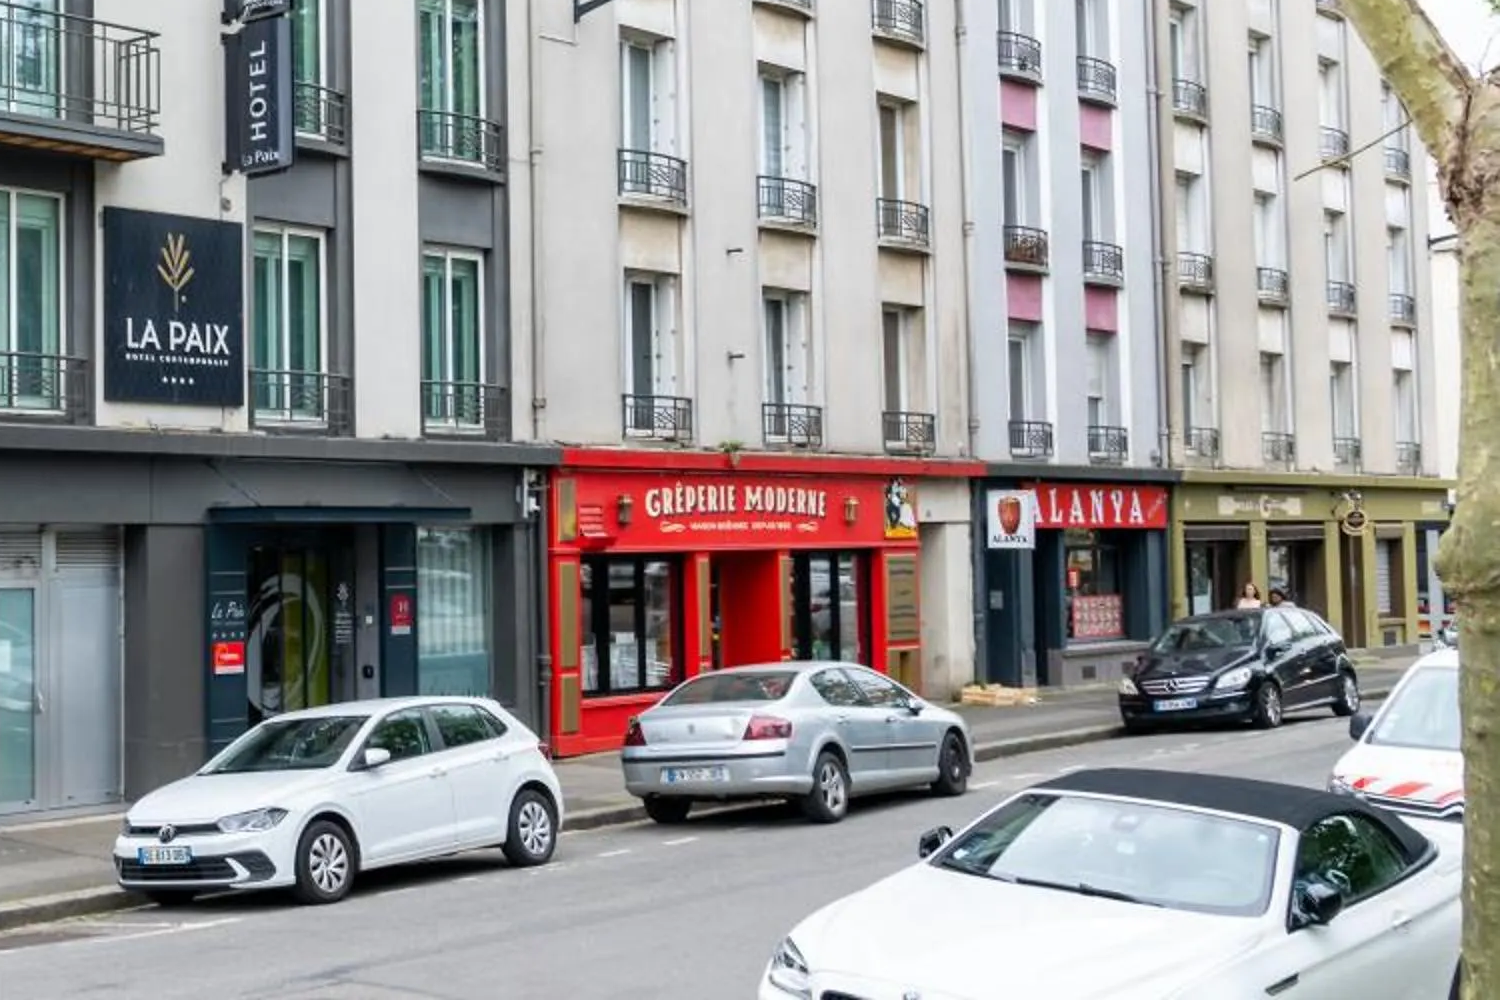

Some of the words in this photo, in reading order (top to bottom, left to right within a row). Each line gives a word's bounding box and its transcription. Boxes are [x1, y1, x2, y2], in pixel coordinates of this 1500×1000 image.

[250, 40, 266, 141] HOTEL
[125, 317, 162, 350] LA
[168, 320, 230, 355] PAIX
[744, 485, 827, 517] MODERNE
[1032, 488, 1145, 524] ALANYA
